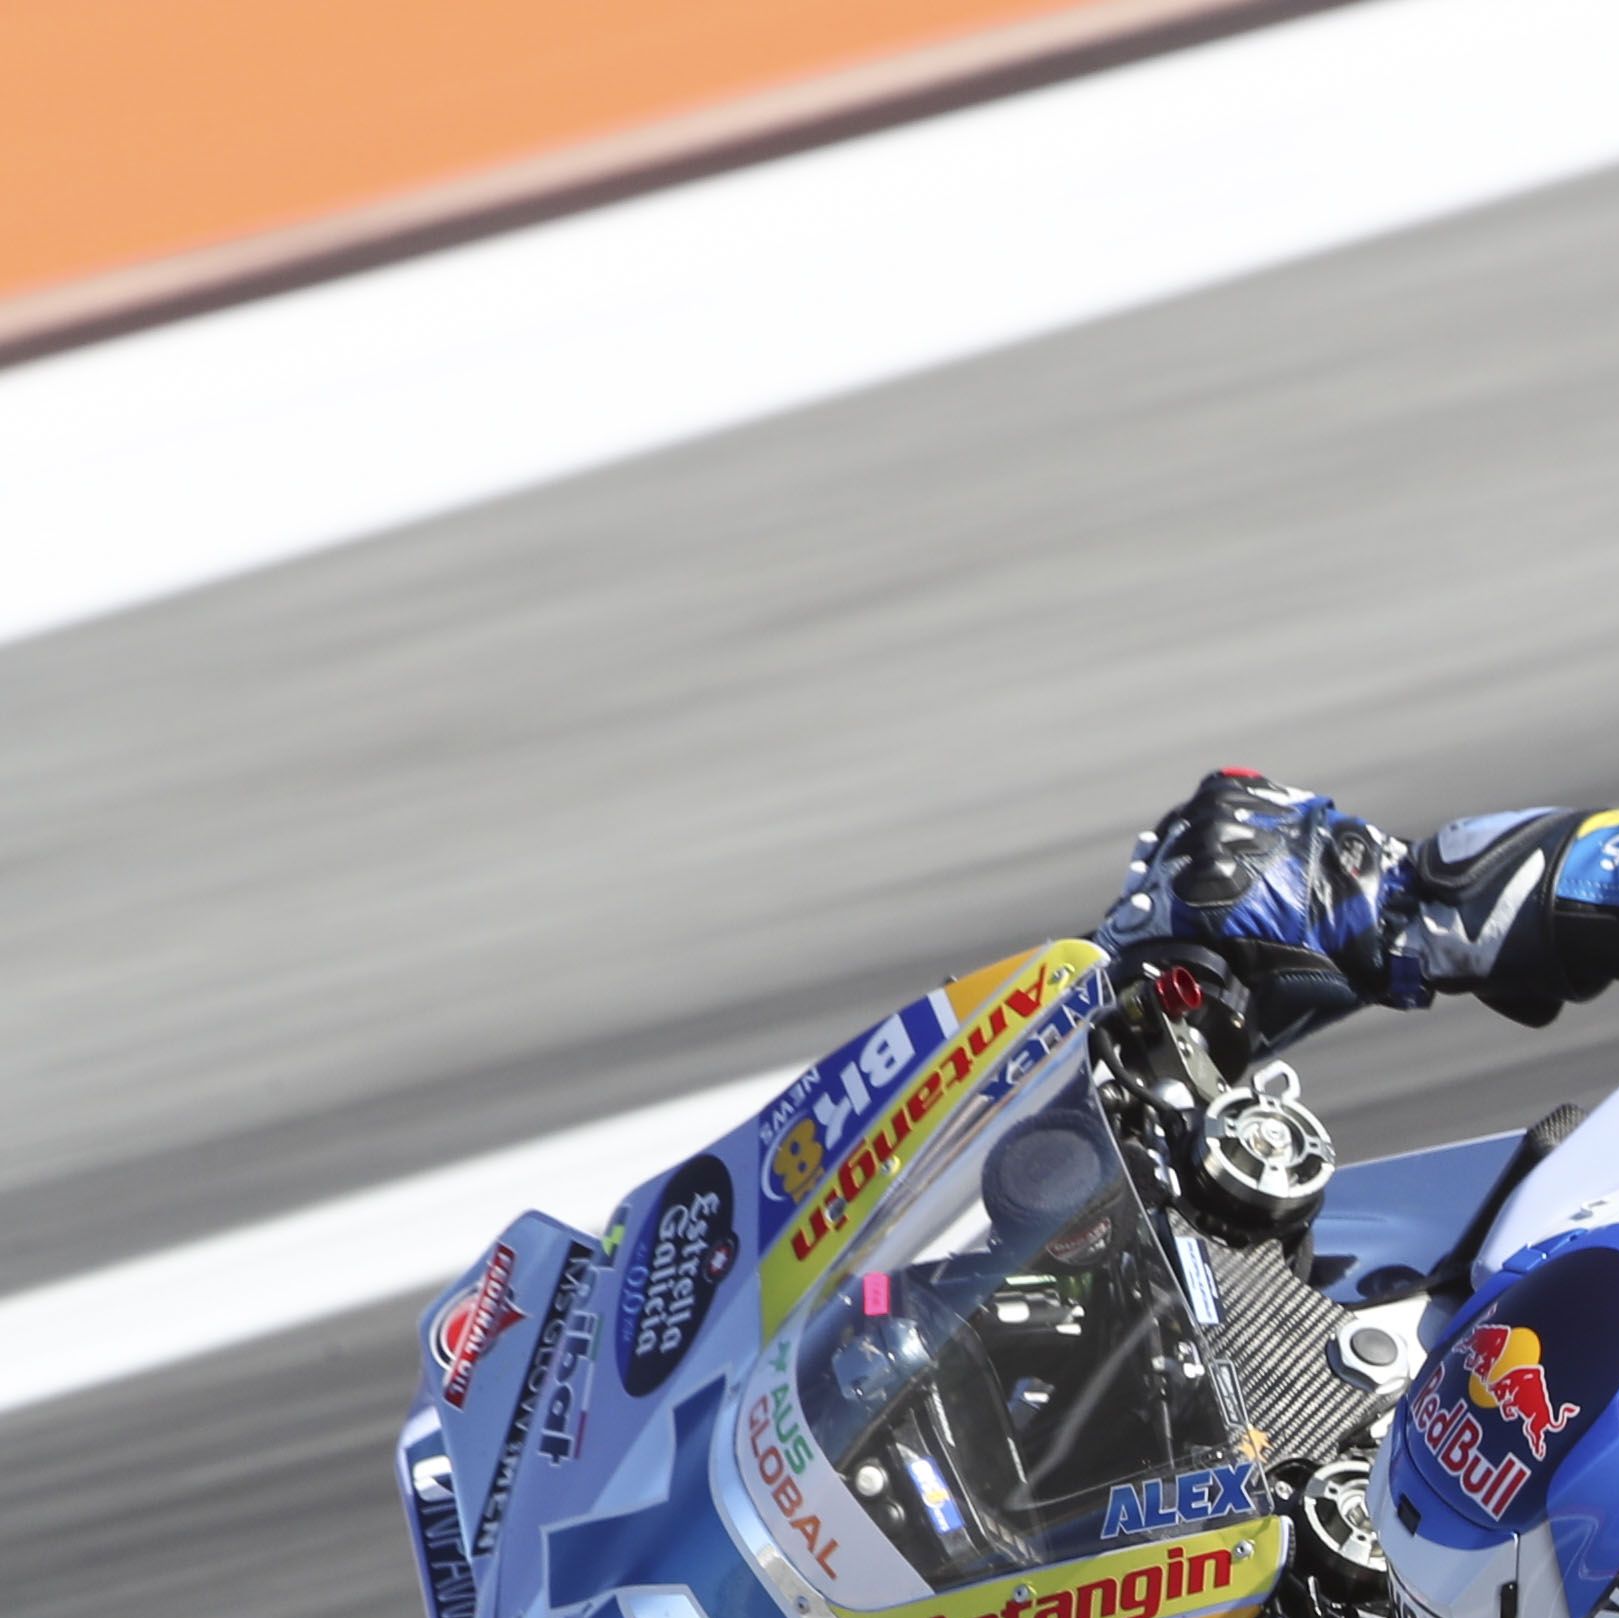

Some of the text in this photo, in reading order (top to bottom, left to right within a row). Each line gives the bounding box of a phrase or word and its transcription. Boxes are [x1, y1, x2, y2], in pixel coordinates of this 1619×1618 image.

[790, 963, 1048, 1262] Antangin
[634, 1204, 689, 1358] Galicia
[658, 1191, 720, 1354] Estrella
[749, 1394, 840, 1581] GLOBAL
[771, 1382, 814, 1476] AUS
[1101, 1462, 1257, 1539] ALEX
